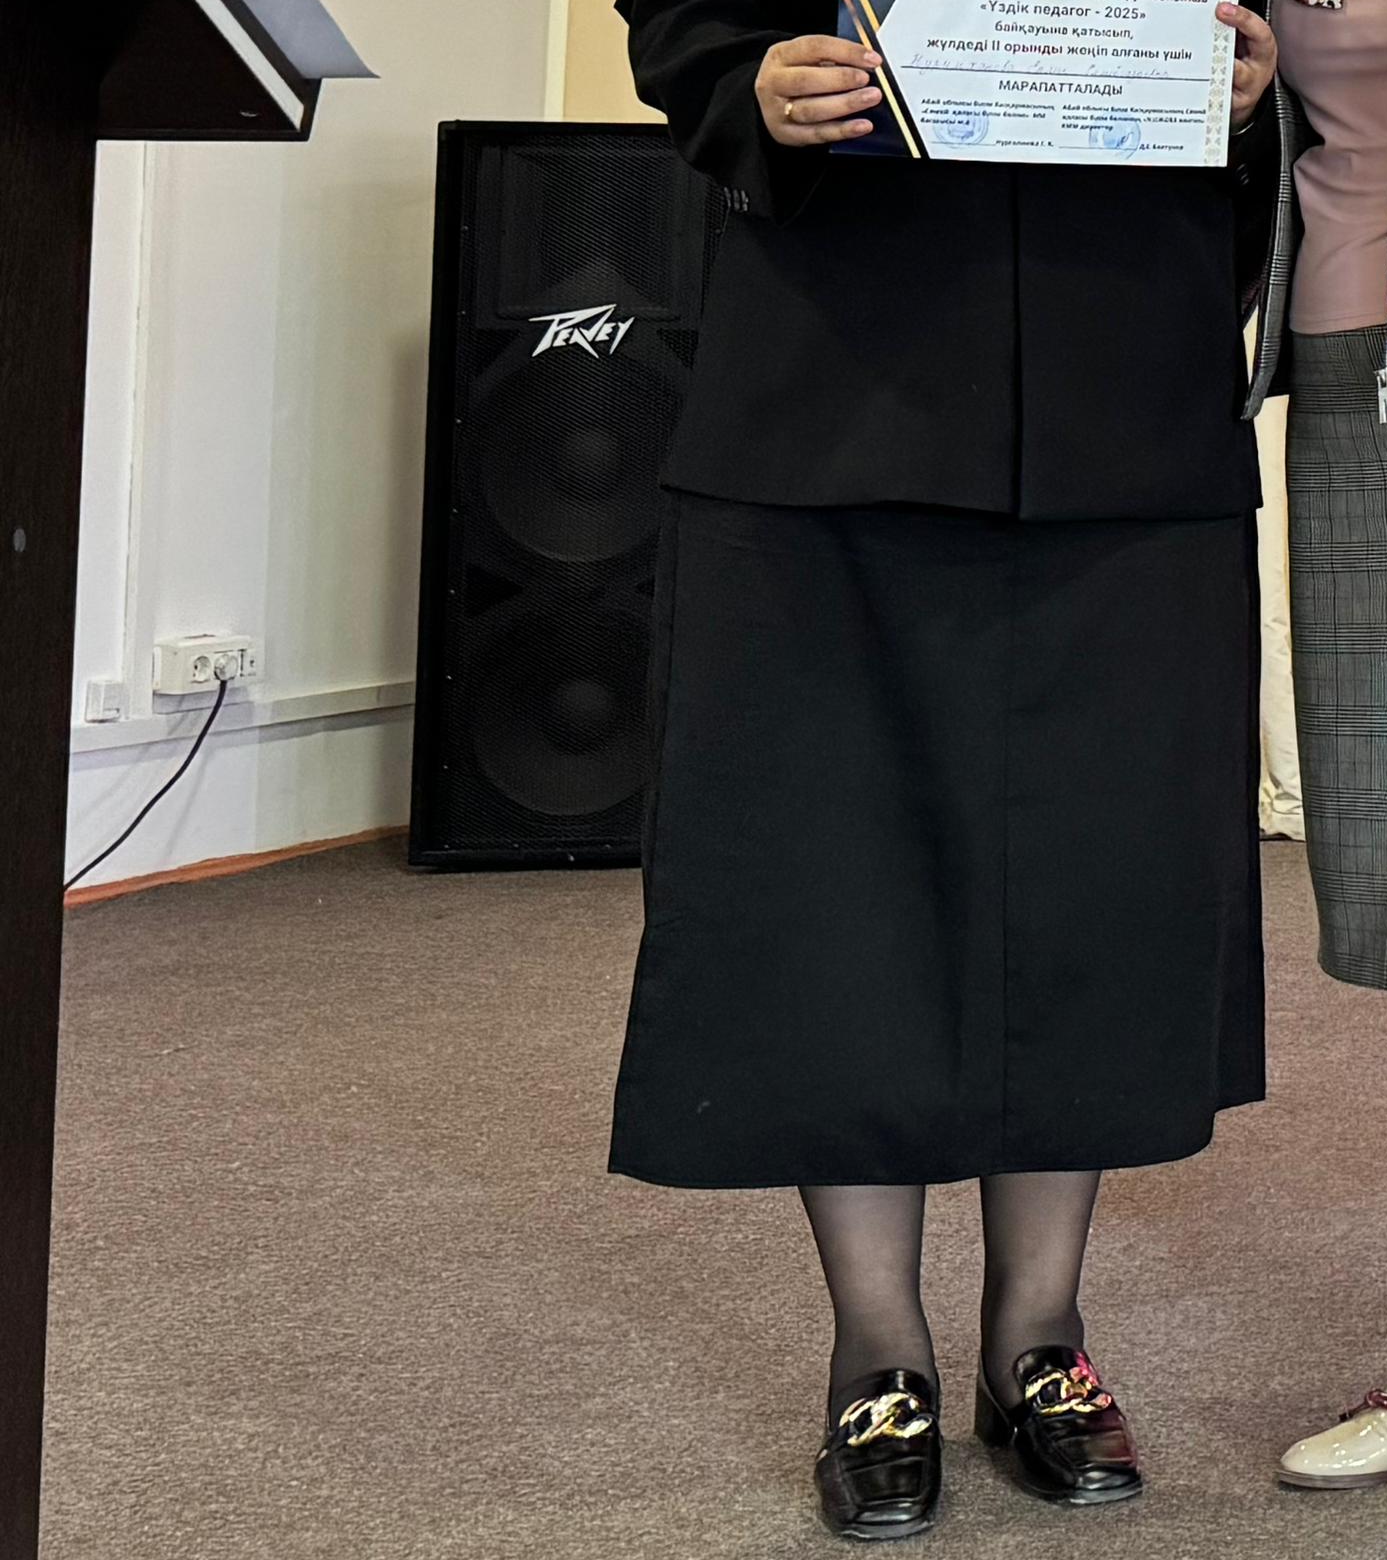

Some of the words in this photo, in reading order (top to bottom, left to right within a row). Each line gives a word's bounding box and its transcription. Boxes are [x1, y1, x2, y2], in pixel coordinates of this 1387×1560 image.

[980, 0, 1029, 16] «Үздік
[1033, 4, 1092, 18] педагог
[1104, 6, 1146, 19] 2025»
[995, 21, 1068, 36] байқауына
[1072, 26, 1134, 40] қатысып,
[927, 39, 988, 51] жүлдеді
[1004, 42, 1063, 55] орынды
[1067, 45, 1108, 58] жеңіп
[1111, 49, 1159, 59] алғаны
[1163, 49, 1192, 61] үшін
[999, 80, 1123, 96] МАРАПАТТАЛАДЫ
[528, 304, 635, 358] PEAVEY
